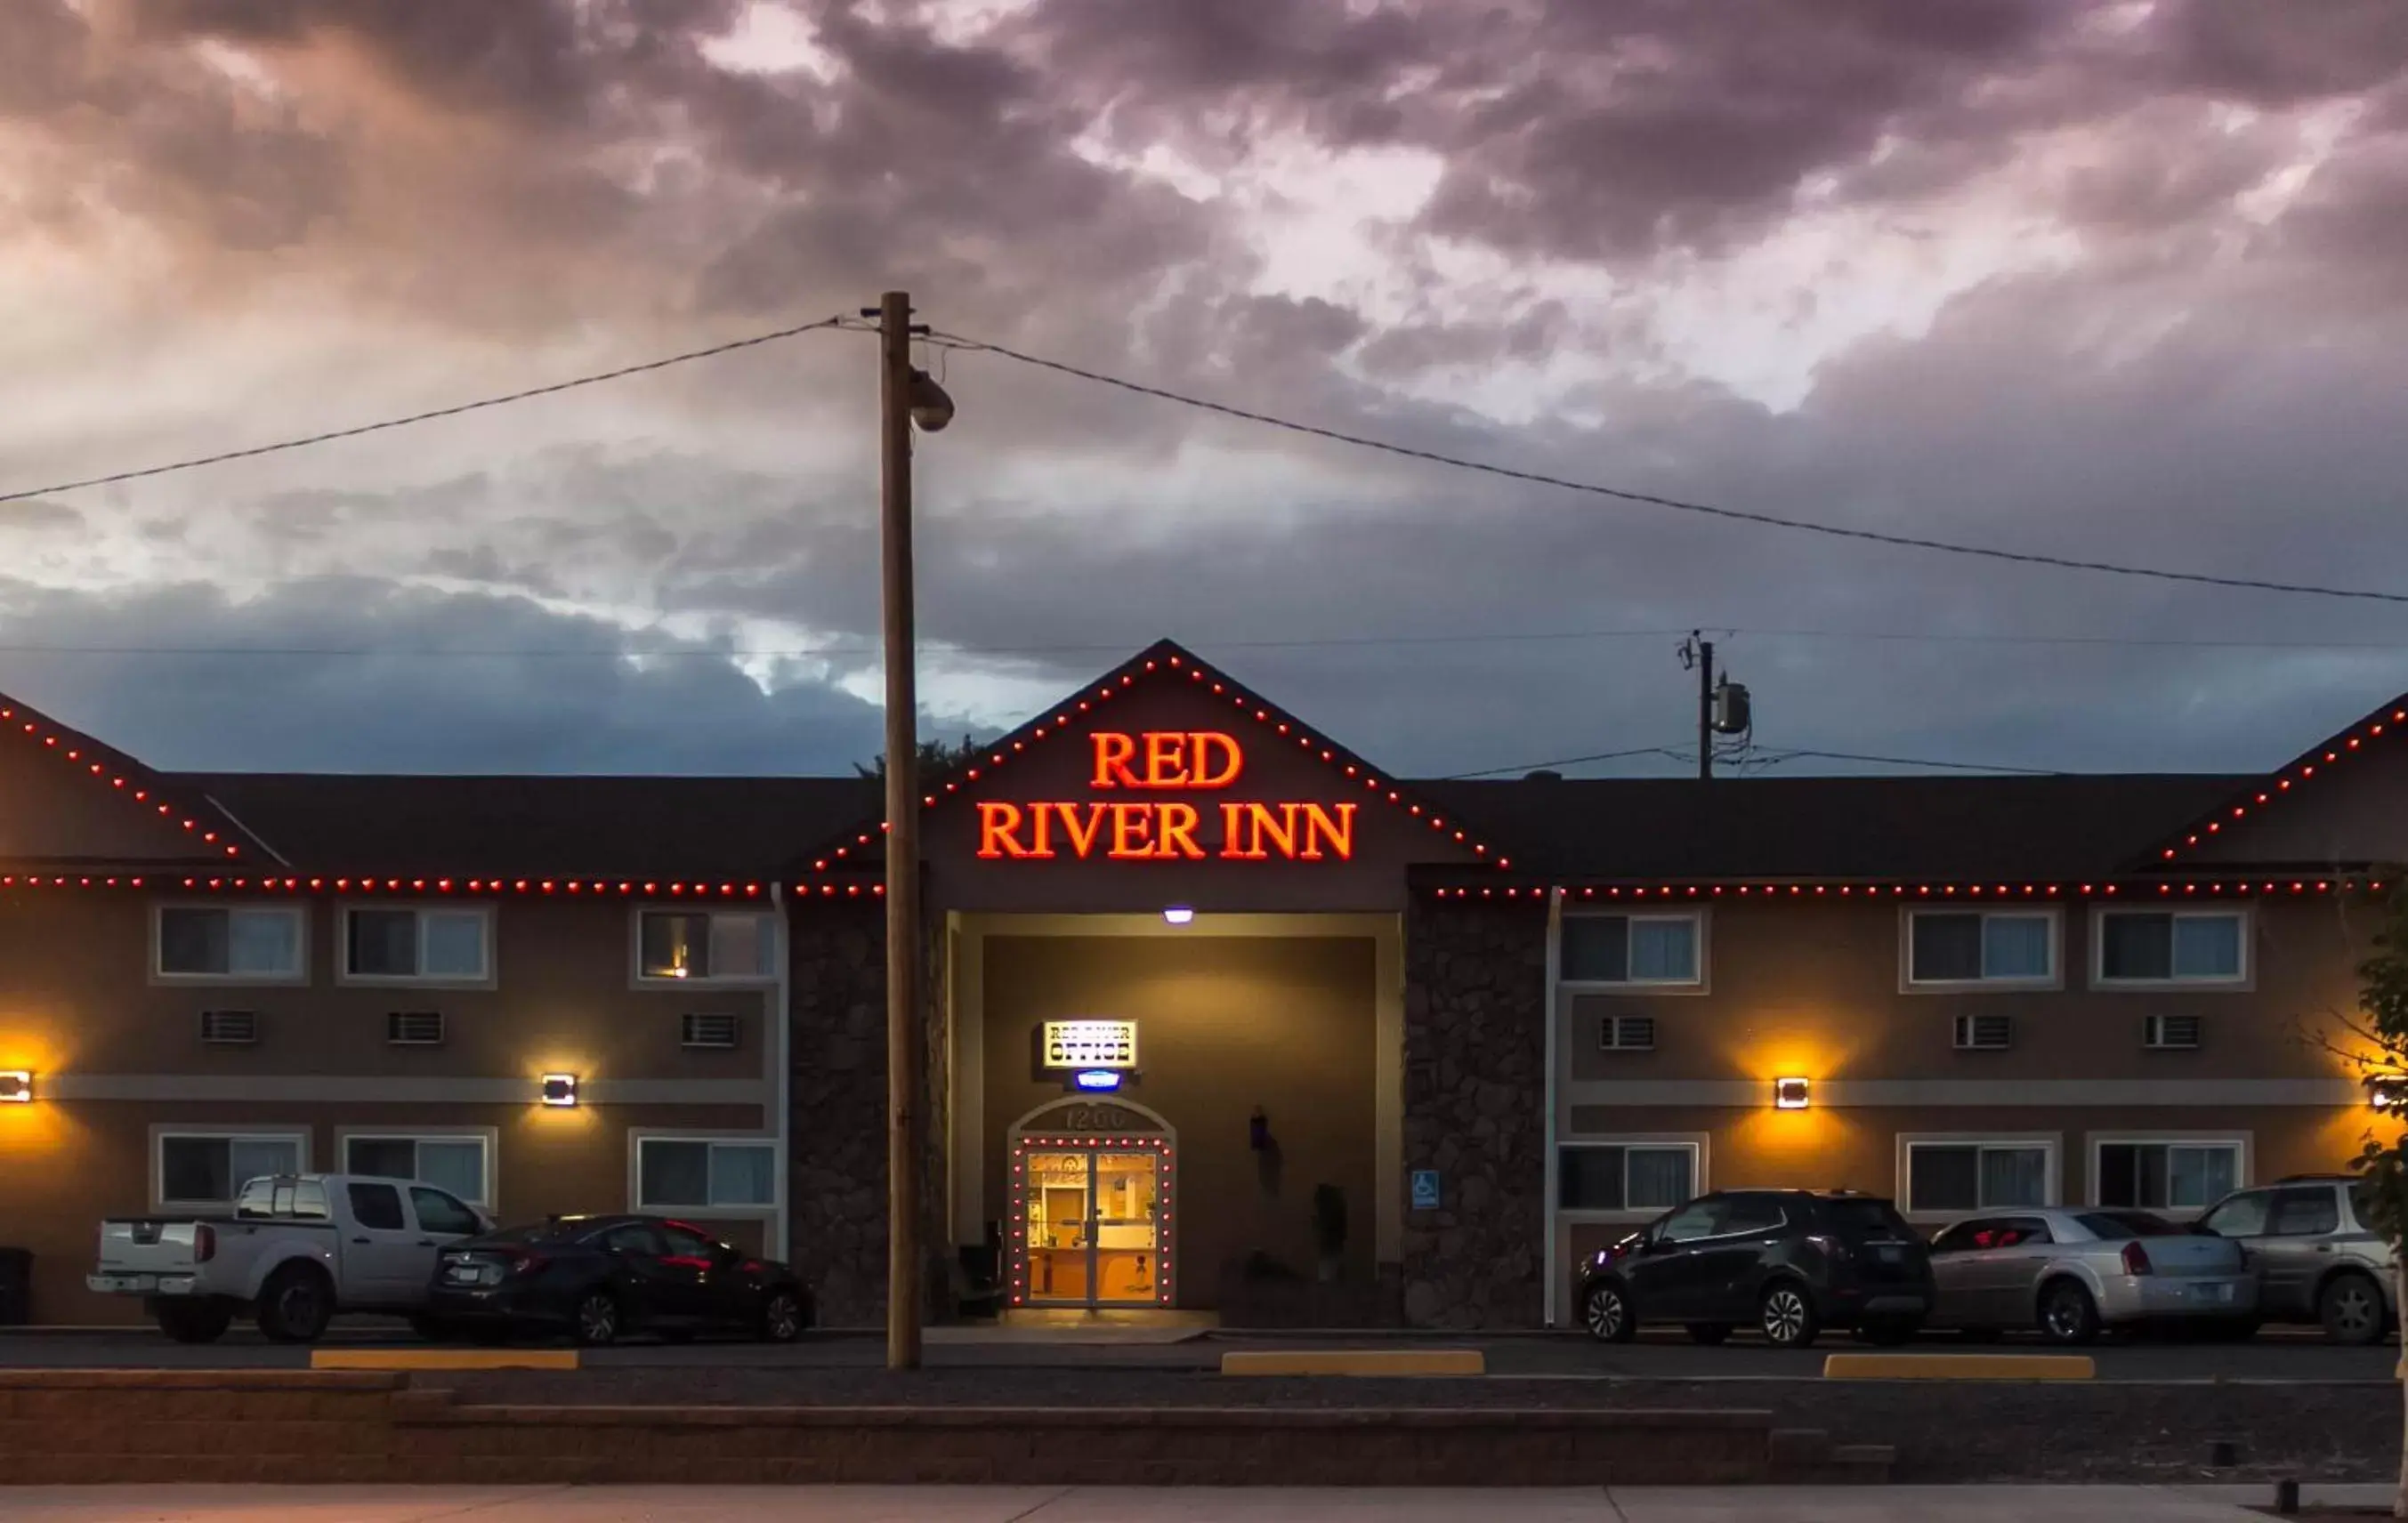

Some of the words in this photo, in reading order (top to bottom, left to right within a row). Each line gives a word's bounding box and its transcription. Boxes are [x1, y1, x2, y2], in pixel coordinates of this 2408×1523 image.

[1090, 731, 1243, 788] RED
[976, 802, 1207, 859] RIVER
[1219, 802, 1357, 860] INN
[1050, 1042, 1130, 1061] OFFICE
